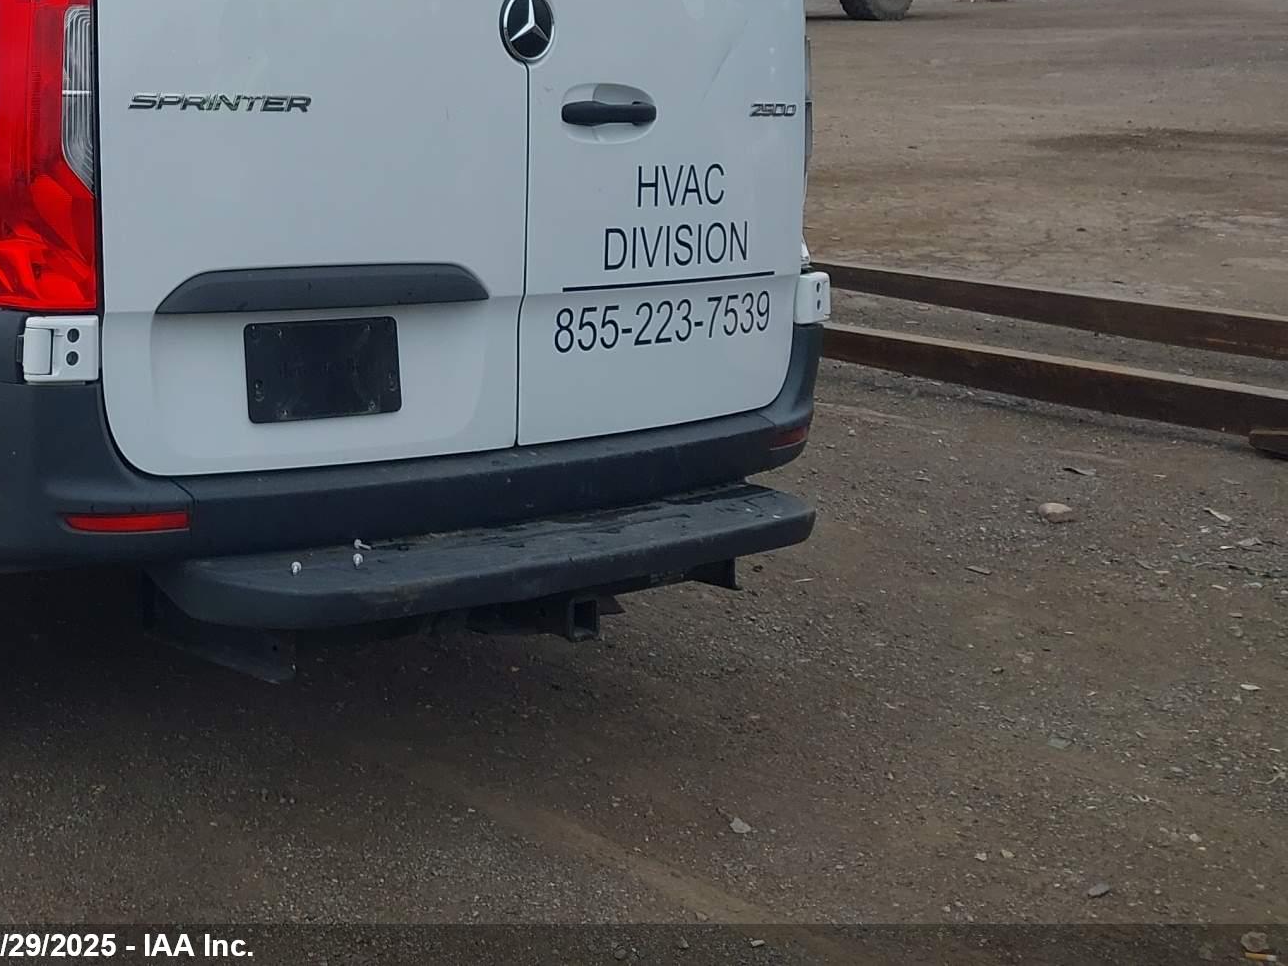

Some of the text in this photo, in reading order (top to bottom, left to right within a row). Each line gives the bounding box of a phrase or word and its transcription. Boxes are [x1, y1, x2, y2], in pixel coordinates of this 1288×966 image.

[128, 93, 312, 113] SPRINTER
[749, 103, 797, 117] 2500
[637, 163, 725, 208] HVAC
[603, 220, 749, 271] DIVISION
[554, 290, 771, 354] 855-223-7539
